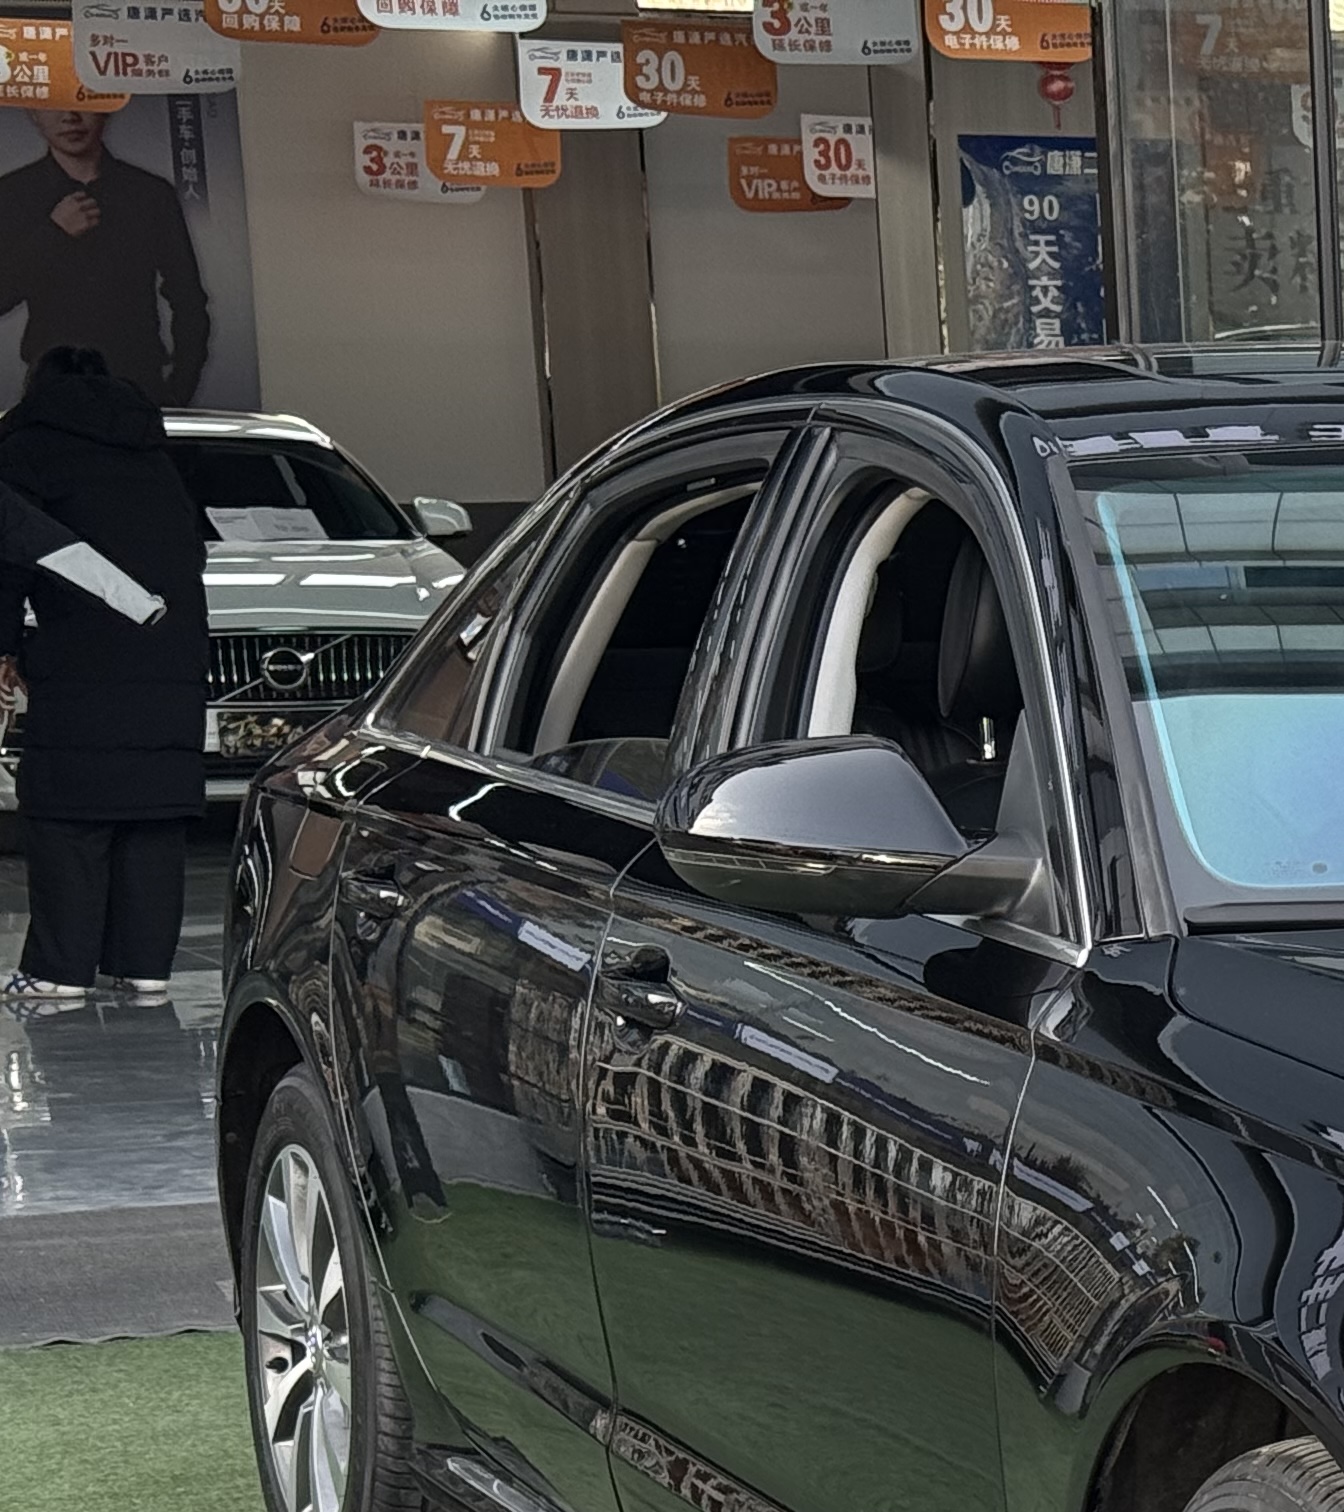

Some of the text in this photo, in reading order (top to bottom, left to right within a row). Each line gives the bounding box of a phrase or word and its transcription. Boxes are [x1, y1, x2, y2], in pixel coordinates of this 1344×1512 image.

[480, 3, 492, 21] 6
[762, 0, 792, 36] 3
[938, 0, 1012, 33] 30 天
[222, 14, 302, 32] 回购保障
[320, 17, 331, 34] 6
[794, 16, 833, 36] 公里
[944, 34, 1021, 51] 电子件保修
[1040, 33, 1050, 50] 6
[1195, 13, 1222, 55] 7
[771, 39, 833, 53] 延长保修
[861, 40, 872, 56] 6
[89, 51, 140, 77] VIP
[635, 50, 701, 91] 30 天
[13, 64, 51, 83] 公里
[182, 69, 194, 85] 6
[0, 85, 49, 99] 长保修
[537, 66, 562, 103] 7
[565, 88, 579, 102] 天
[638, 92, 706, 108] 电子件保修
[540, 105, 600, 120] 无忧退换
[616, 105, 626, 120] 6
[441, 124, 467, 161] 7
[468, 144, 482, 159] 天
[362, 143, 419, 177] 3 公里
[812, 136, 867, 172] 30 天
[443, 161, 500, 177] 无忧退换
[817, 173, 872, 186] 电子件保修
[739, 178, 778, 200] VIP
